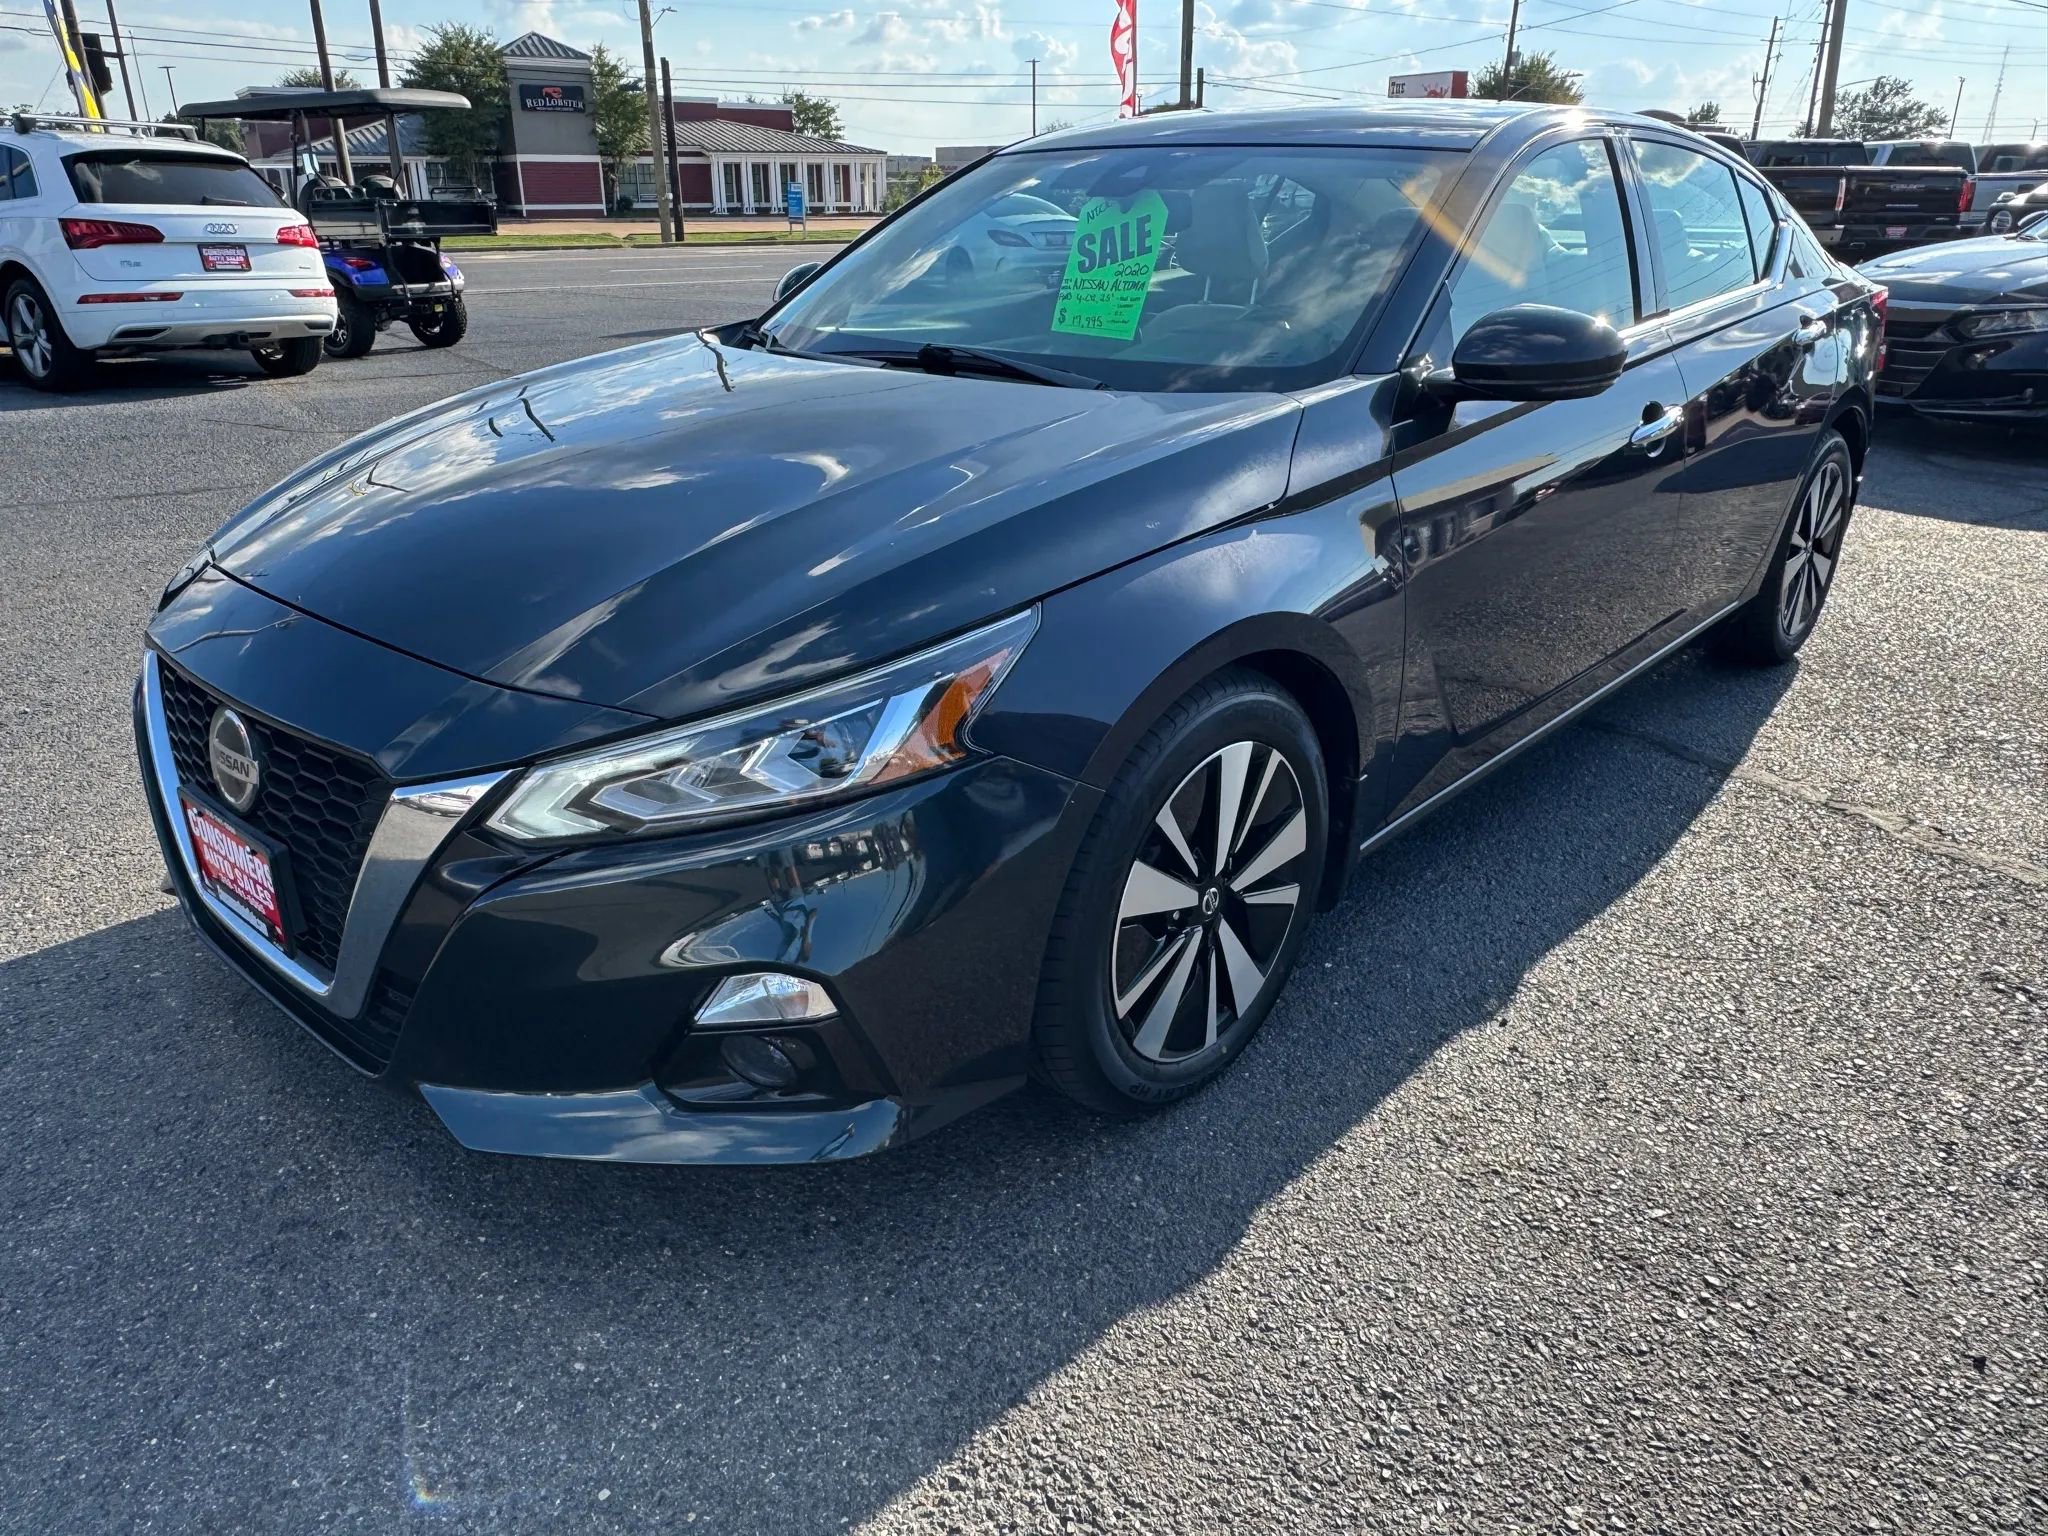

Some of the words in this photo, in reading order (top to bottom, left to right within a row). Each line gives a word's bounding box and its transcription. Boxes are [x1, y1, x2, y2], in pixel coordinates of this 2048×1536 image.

[526, 98, 545, 108] RED
[546, 97, 584, 109] LOBSTER
[1077, 214, 1153, 274] SALE
[1114, 262, 1150, 277] 2020
[1072, 277, 1110, 292] NISSAN
[1058, 307, 1067, 324] $
[216, 748, 250, 778] SSAN
[187, 808, 275, 894] CONSUMERS
[202, 844, 235, 880] AUTO
[233, 868, 275, 911] SALES
